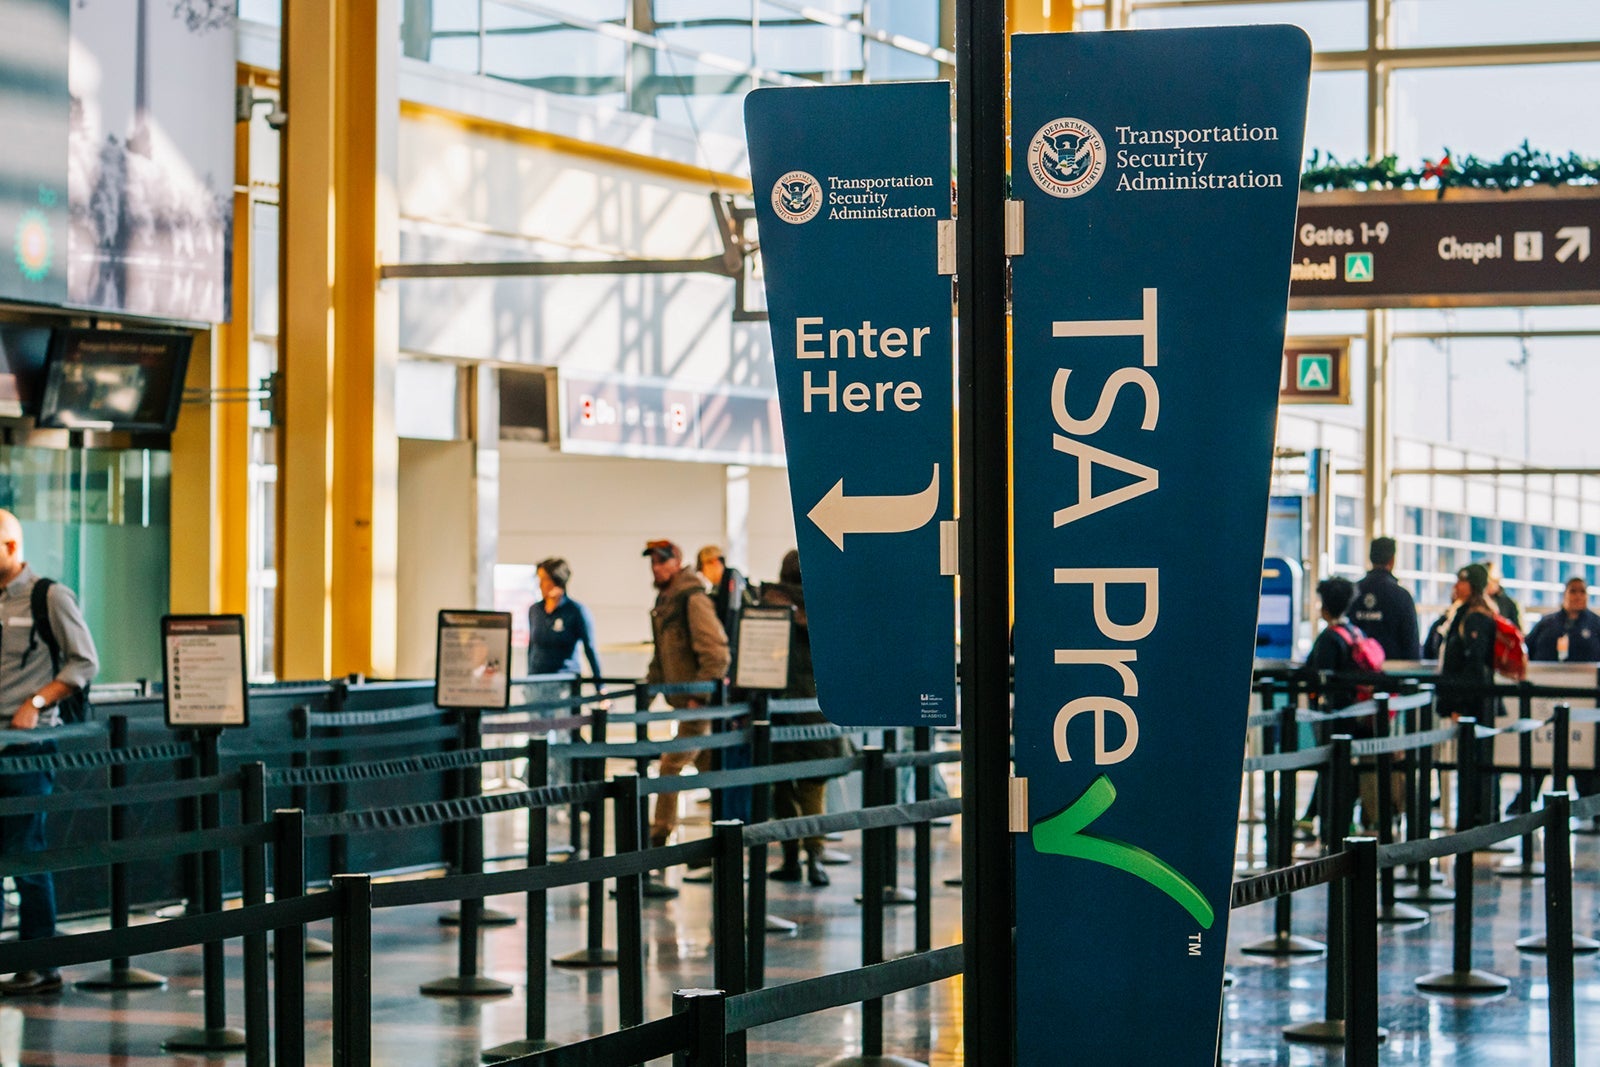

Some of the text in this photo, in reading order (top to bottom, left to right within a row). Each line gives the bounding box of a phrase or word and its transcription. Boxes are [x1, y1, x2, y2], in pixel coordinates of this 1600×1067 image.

[1044, 122, 1097, 140] DEPARTMENT
[1093, 140, 1102, 151] OF
[1115, 123, 1279, 149] Transportation
[1116, 148, 1208, 171] Security
[827, 174, 934, 192] Transportation
[1032, 161, 1102, 194] HOMELAND SECURITY
[1115, 169, 1283, 191] Administration
[828, 191, 889, 207] Security
[828, 205, 937, 220] Administration
[1300, 221, 1390, 247] Gates 1-9
[1437, 234, 1502, 265] Chapel
[796, 316, 931, 359] Enter
[803, 370, 923, 413] Here
[1051, 287, 1202, 956] TSA Pre TM
